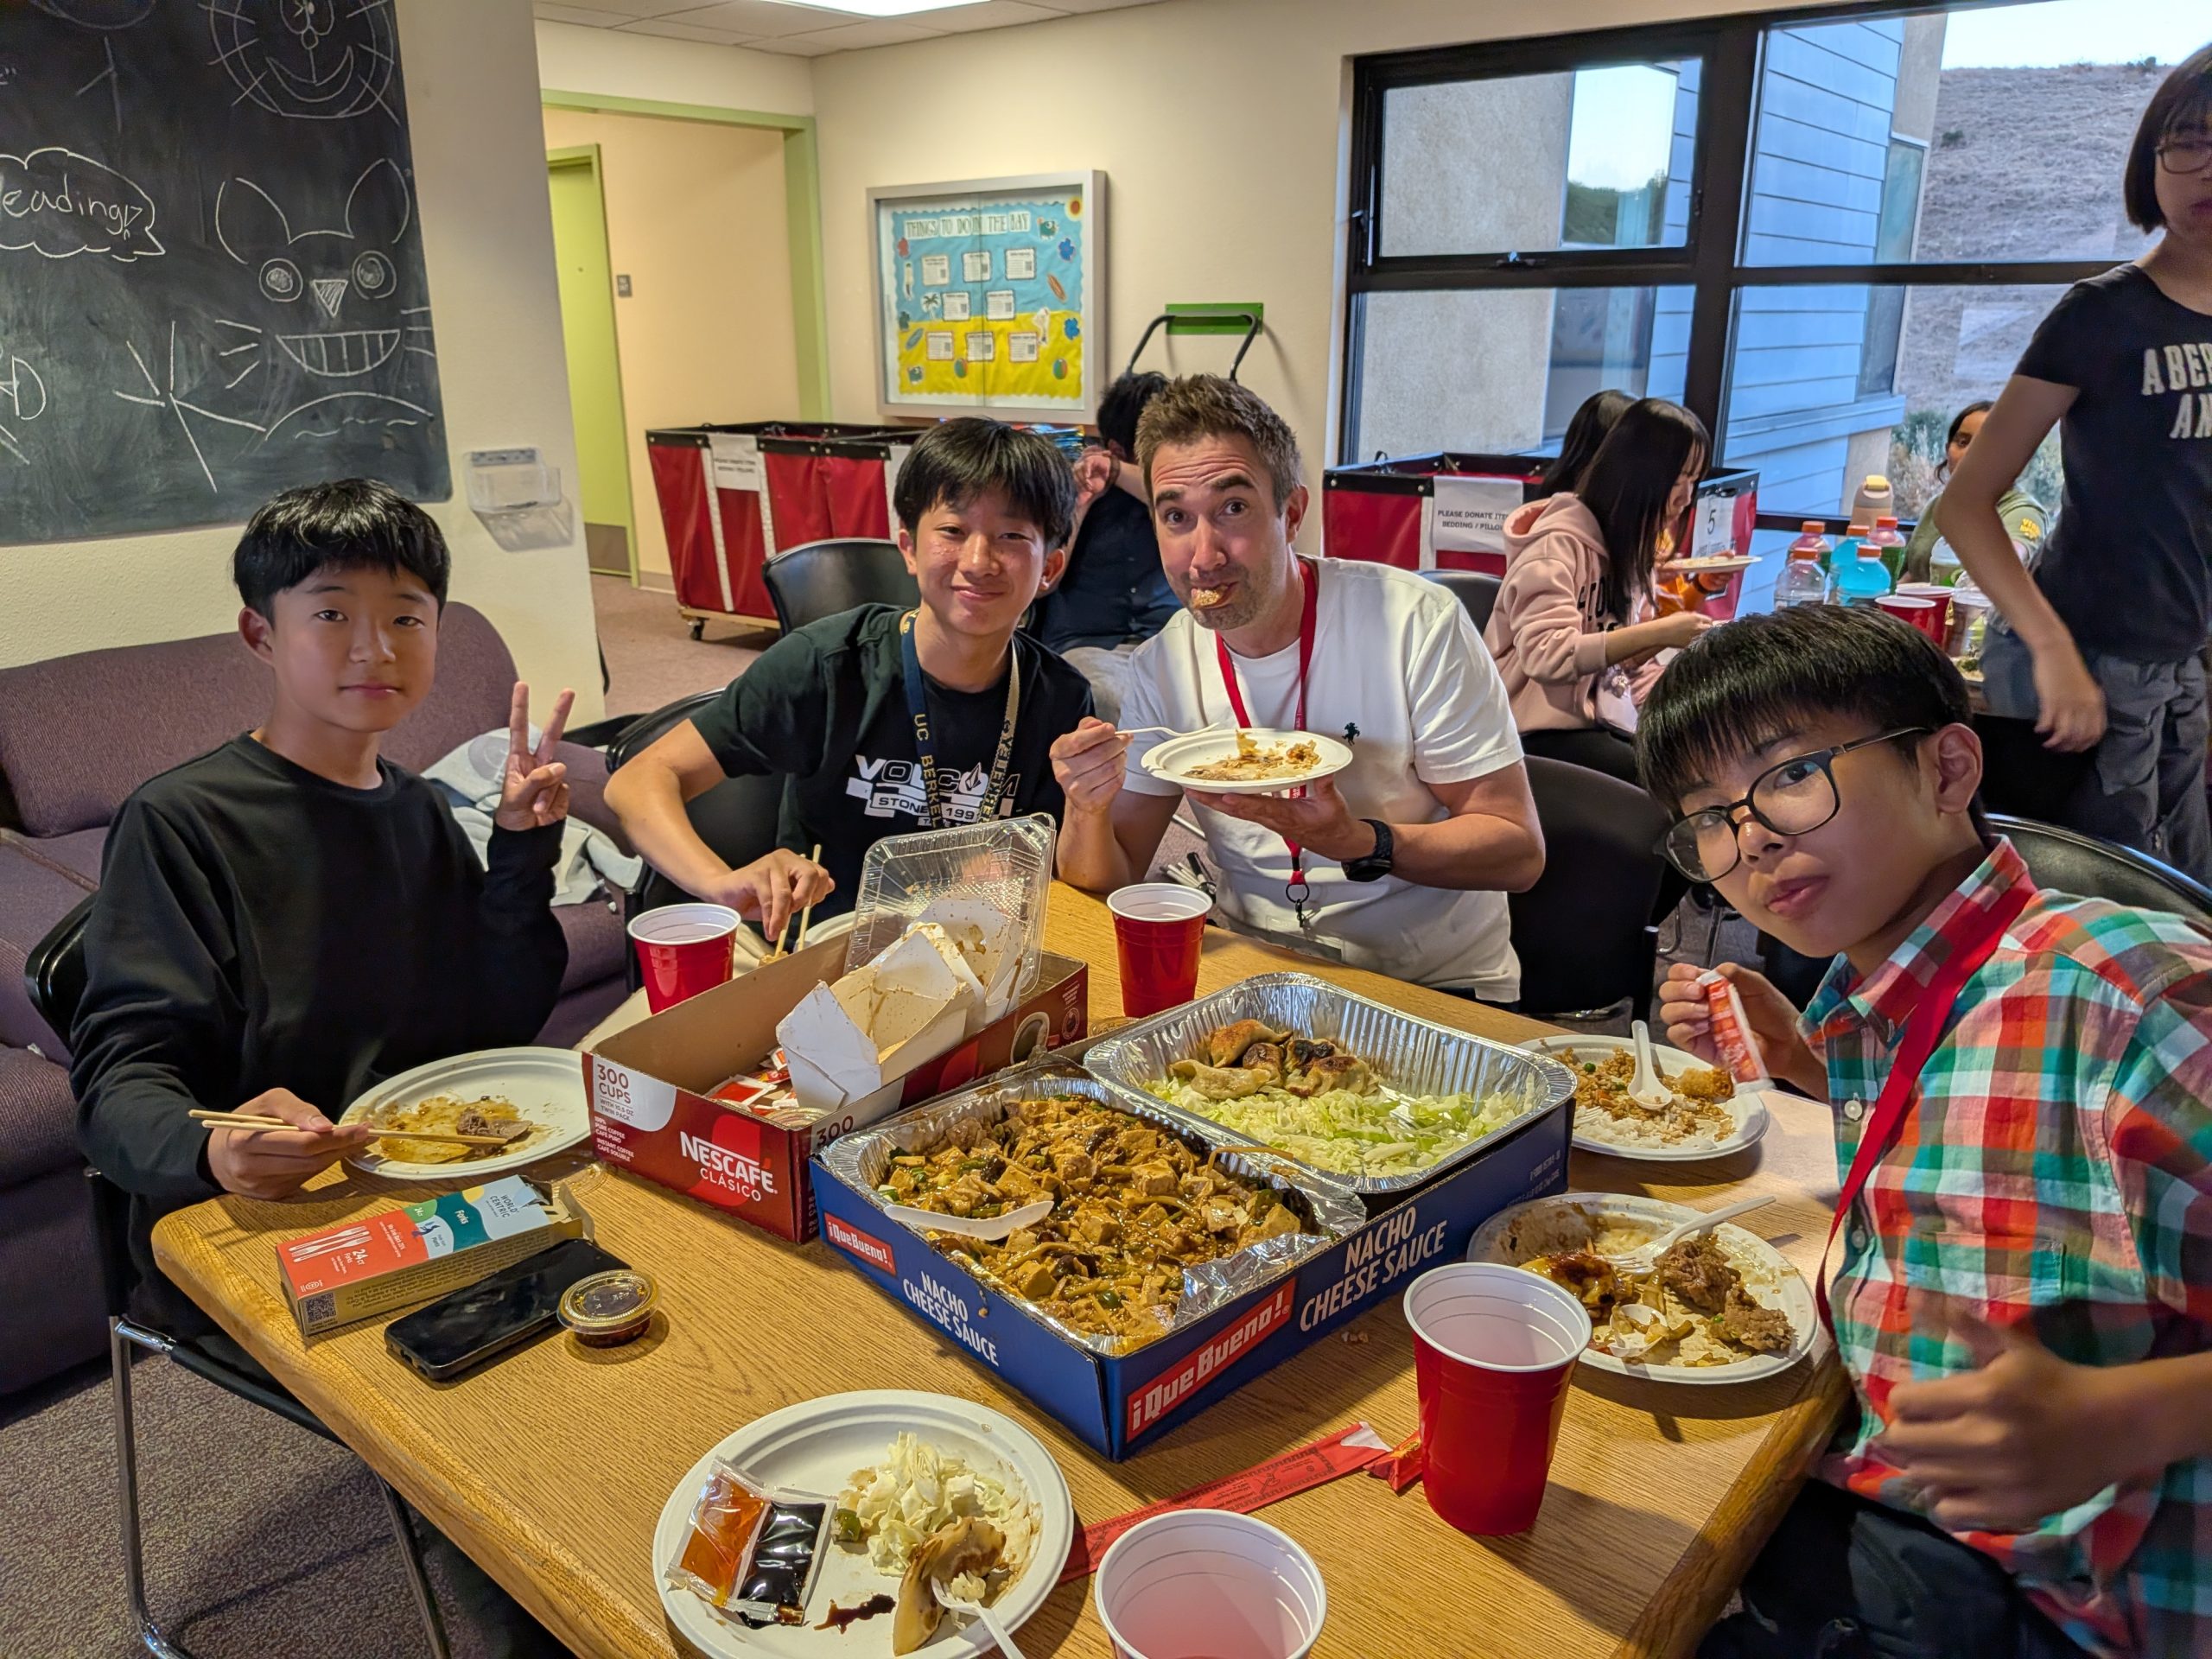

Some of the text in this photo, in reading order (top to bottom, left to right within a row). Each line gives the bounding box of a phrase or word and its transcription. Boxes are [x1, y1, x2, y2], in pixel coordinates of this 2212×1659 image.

[1707, 509, 1716, 535] 5
[914, 714, 929, 741] UC
[878, 797, 930, 814] STONE
[597, 1064, 629, 1090] 300
[599, 1083, 631, 1104] CUPS
[601, 1098, 613, 1109] WITH
[601, 1106, 631, 1122] TWIN PACK
[595, 1122, 626, 1139] PURE COFFEE
[608, 1134, 621, 1143] PURO
[817, 1116, 854, 1147] 300
[596, 1137, 634, 1158] INSTANT COFFEE
[610, 1149, 631, 1162] SOLUBLE
[700, 1167, 761, 1201] CLÁSICO
[490, 1196, 510, 1217] CENTRIC
[500, 1195, 518, 1213] WORLD
[454, 1210, 469, 1224] Forks
[1344, 1206, 1416, 1273] NACHO
[1300, 1220, 1447, 1332] CHEESE SAUCE
[921, 1271, 968, 1322] NACHO
[903, 1279, 999, 1366] CHEESE SAUCE
